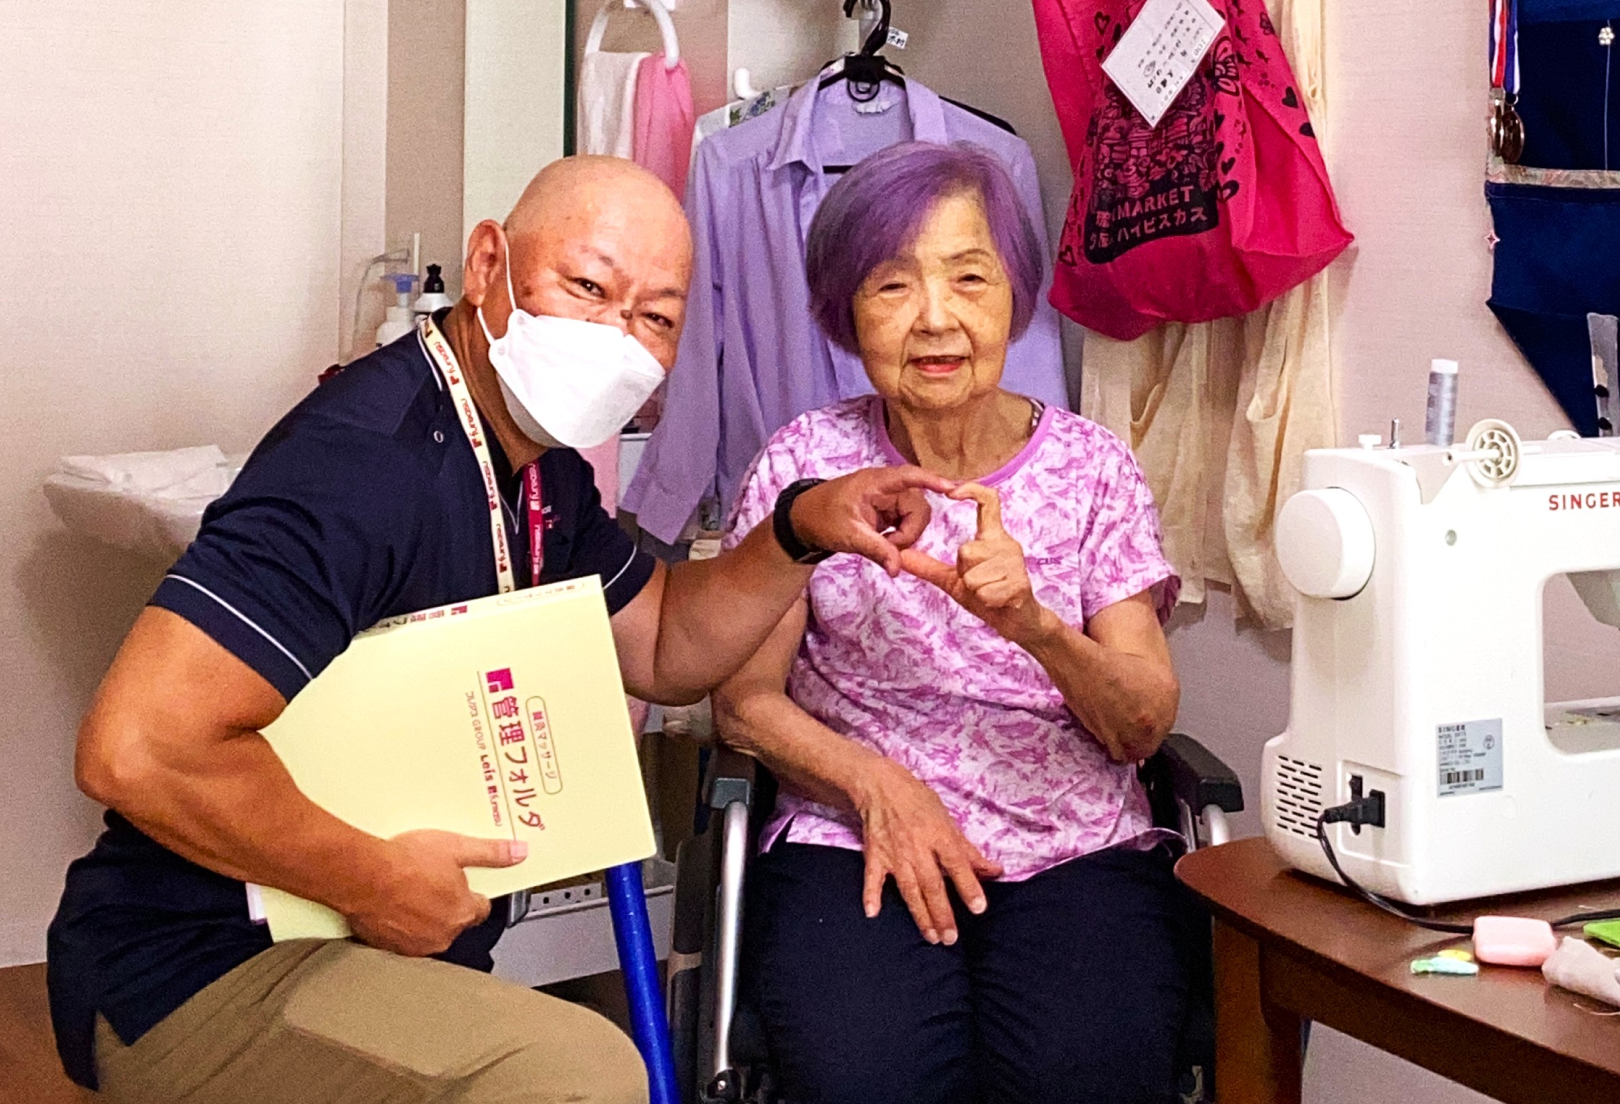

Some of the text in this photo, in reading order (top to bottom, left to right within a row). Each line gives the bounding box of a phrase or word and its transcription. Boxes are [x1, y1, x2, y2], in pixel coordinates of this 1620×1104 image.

[1117, 185, 1194, 220] MARKET
[1117, 206, 1208, 242] ハイビスカス
[1548, 491, 1620, 511] SINGER
[472, 719, 487, 751] GROUP
[480, 754, 497, 782] Leis
[491, 695, 546, 832] 管理フォルダ
